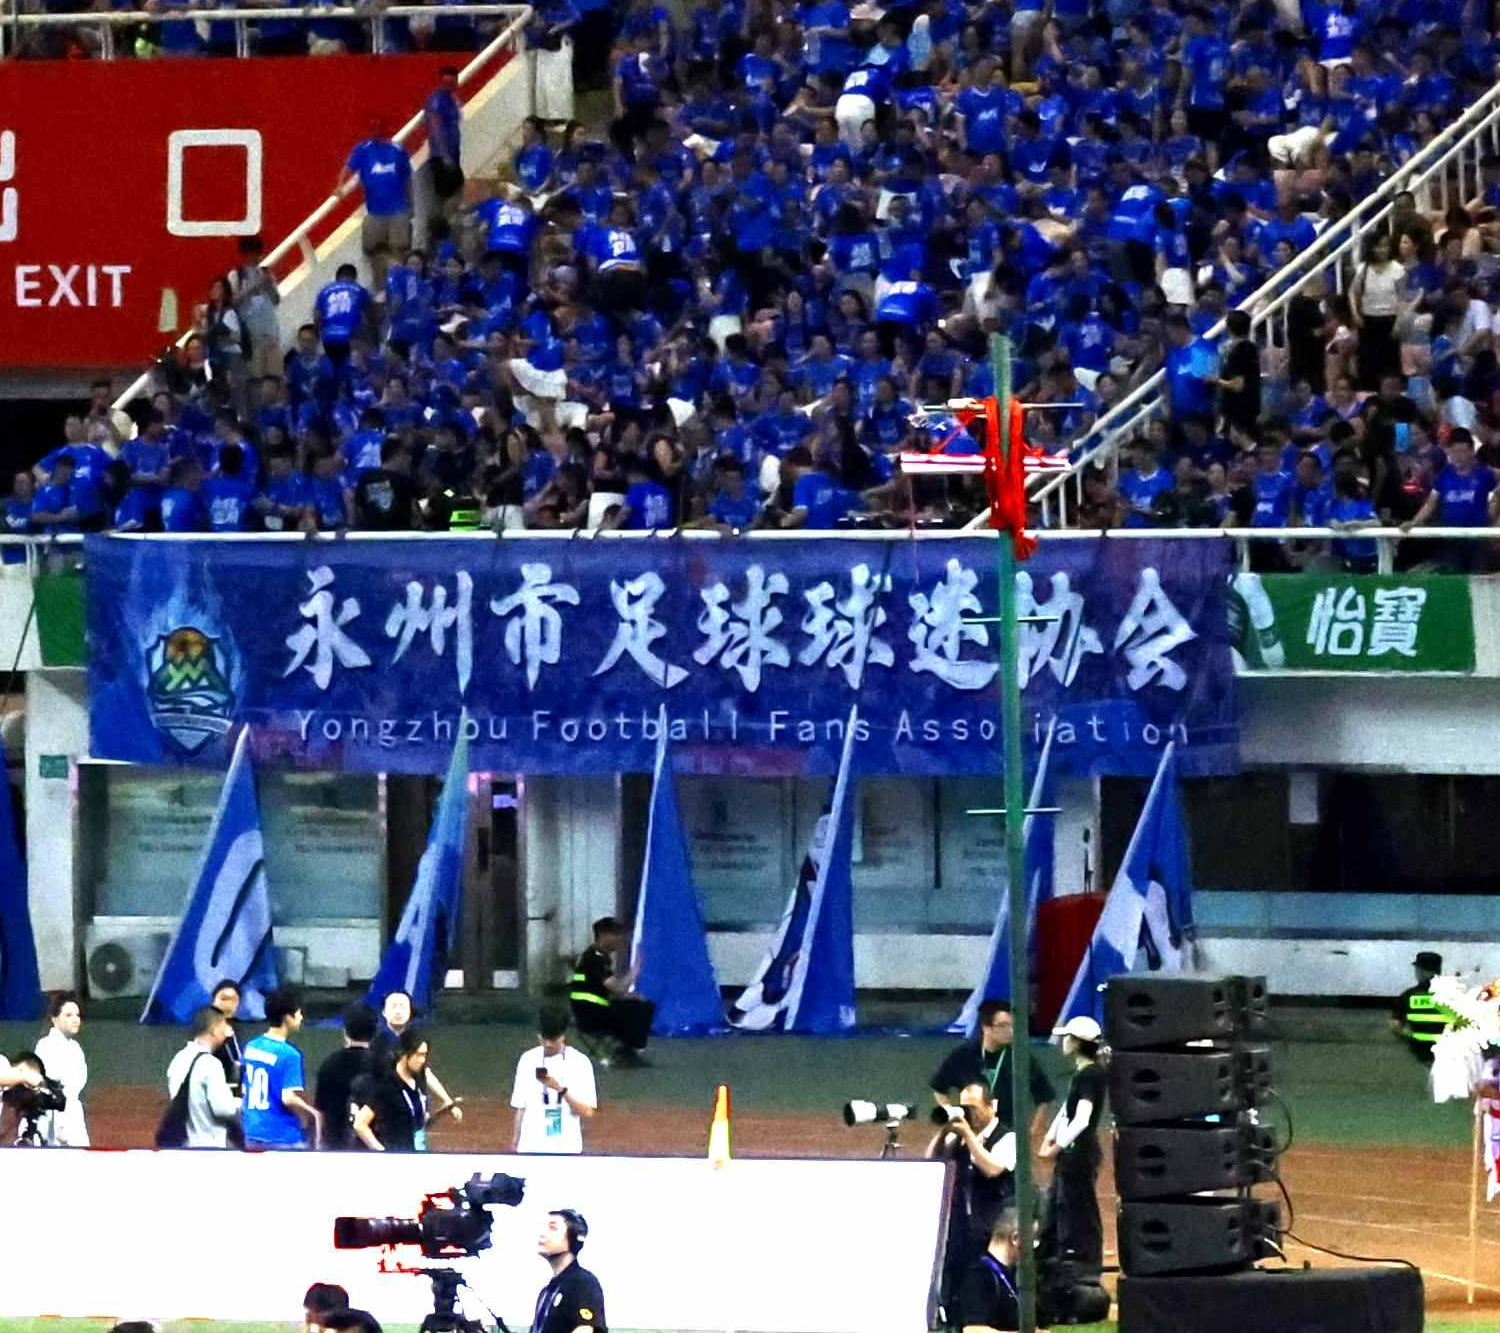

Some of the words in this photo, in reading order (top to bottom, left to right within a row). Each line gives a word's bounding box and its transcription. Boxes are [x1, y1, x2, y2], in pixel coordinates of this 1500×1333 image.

[15, 264, 132, 309] EXIT
[282, 557, 1199, 697] 永州市足球球迷协会
[297, 709, 508, 749] Yongzhou
[533, 708, 738, 741] Football
[769, 709, 870, 742] Fans
[894, 709, 1188, 746] Assoiation
